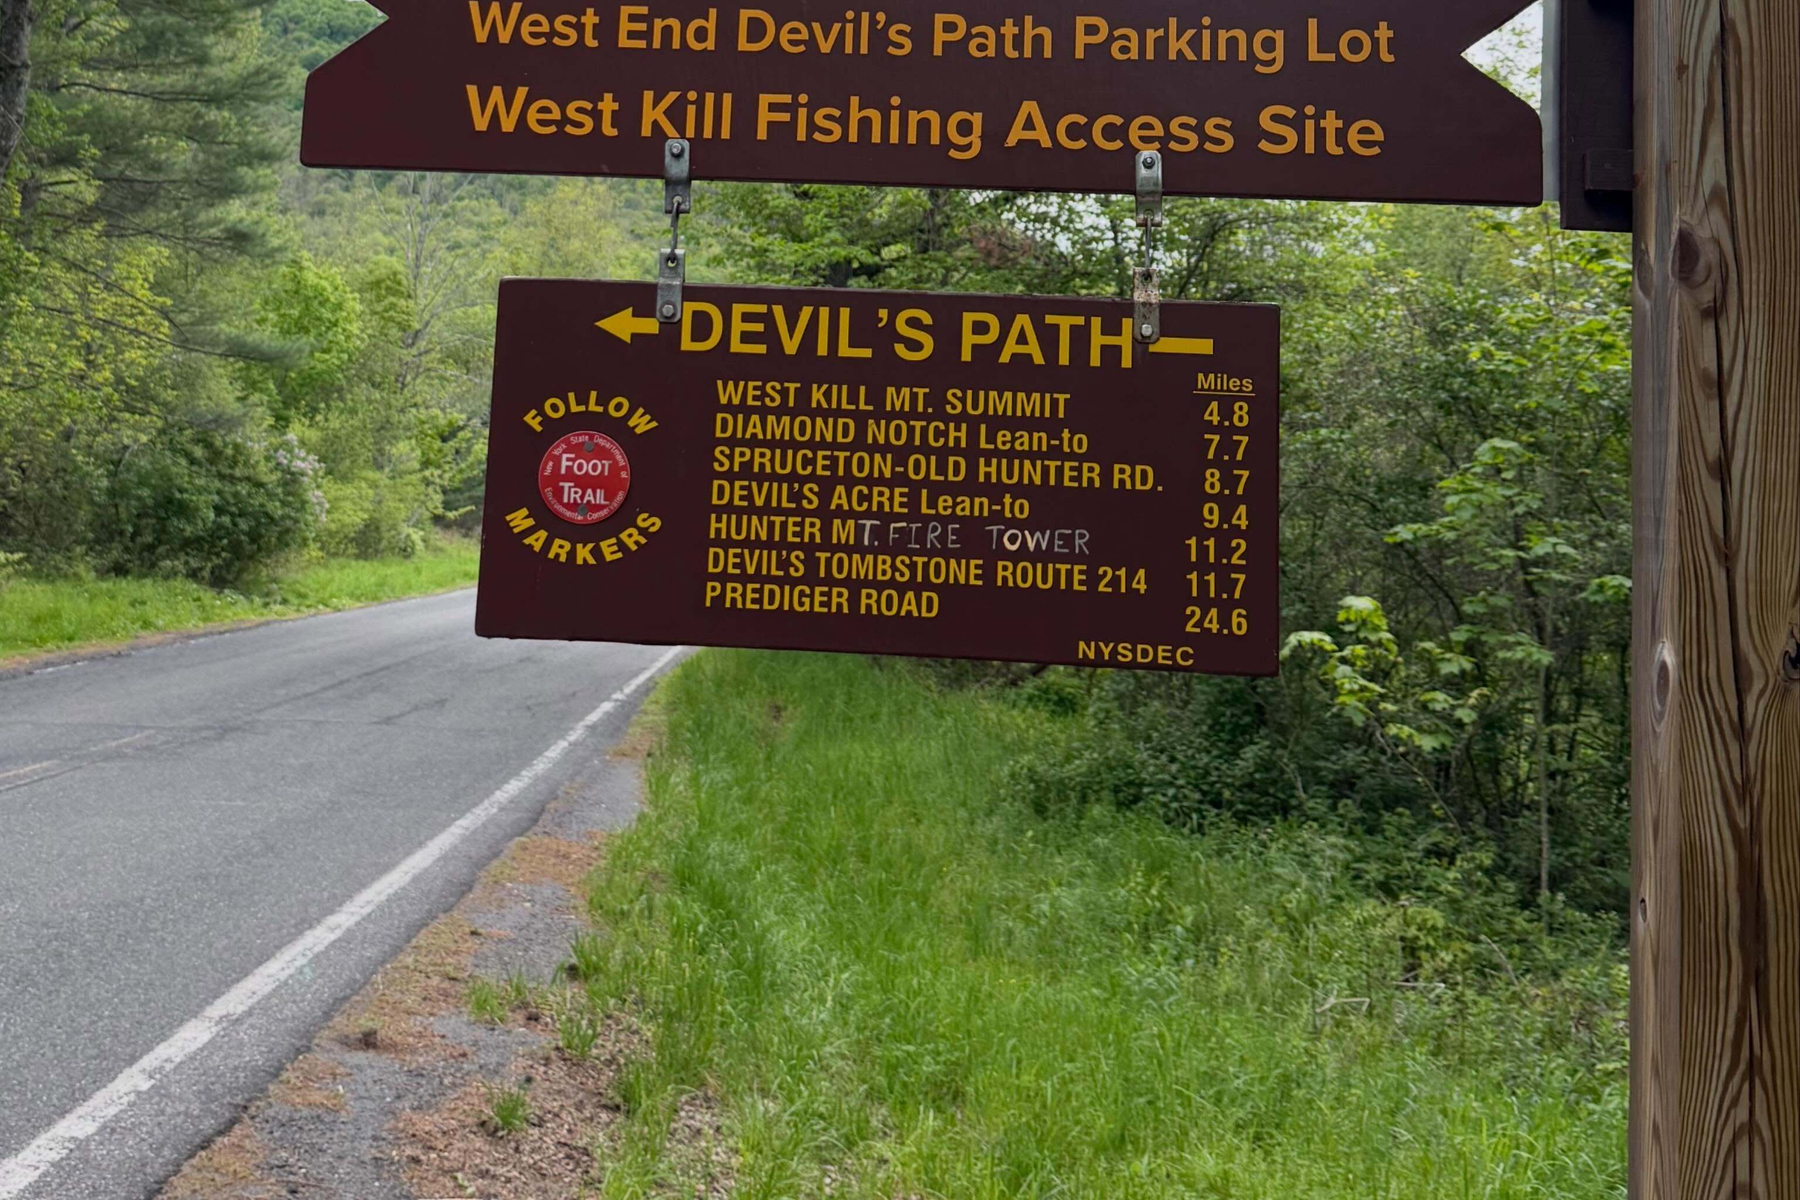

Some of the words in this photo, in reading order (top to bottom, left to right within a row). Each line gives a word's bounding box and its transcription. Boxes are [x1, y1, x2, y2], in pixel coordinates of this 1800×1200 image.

[469, 0, 599, 47] West
[618, 5, 717, 50] End
[738, 9, 912, 56] Devil's
[933, 13, 1052, 58] Path
[1075, 16, 1284, 73] Parking
[1308, 18, 1395, 62] Lot
[466, 84, 619, 136] West
[641, 90, 732, 139] Kill
[757, 93, 982, 159] Fishing
[1004, 101, 1234, 153] Access
[1258, 105, 1384, 156] Site
[680, 301, 934, 361] DEVIL'S
[961, 312, 1133, 368] PATH
[1198, 373, 1252, 391] Miles
[523, 390, 658, 434] FOLLOW
[717, 380, 801, 407] WEST
[811, 384, 873, 410] KILL
[886, 387, 932, 412] MT.
[946, 389, 1070, 418] SUMMIT
[1204, 401, 1249, 427] 4.8
[715, 413, 855, 443] DIAMOND
[867, 419, 966, 448] NOTCH
[980, 424, 1087, 453] Lean-to
[1204, 434, 1249, 460] 7.7
[552, 443, 567, 456] York
[570, 435, 589, 444] State
[593, 435, 626, 466] Department
[560, 453, 612, 476] FOOT
[713, 446, 966, 481] SPRUCETON-OLD
[979, 458, 1100, 487] HUNTER
[1113, 464, 1162, 491] RD.
[1205, 469, 1249, 494] 8.7
[559, 481, 611, 505] TRAIL
[712, 480, 819, 509] DEVIL'S
[830, 485, 909, 513] ACRE
[921, 489, 1029, 519] Lean-to
[1203, 503, 1248, 529] 9.4
[505, 507, 661, 565] MARKERS
[710, 513, 821, 543] HUNTER
[889, 520, 962, 549] FIRE
[985, 525, 1090, 555] TOWER
[1185, 536, 1246, 564] 11.2
[708, 547, 804, 577] DEVIL'S
[815, 552, 983, 585] TOMBSTONE
[997, 561, 1087, 591] ROUTE
[1098, 566, 1147, 594] 214
[1187, 571, 1246, 599] 11.7
[706, 582, 849, 613] PREDIGER
[860, 589, 938, 617] ROAD
[1185, 606, 1247, 635] 24.6
[1079, 641, 1193, 665] NYSDEC
